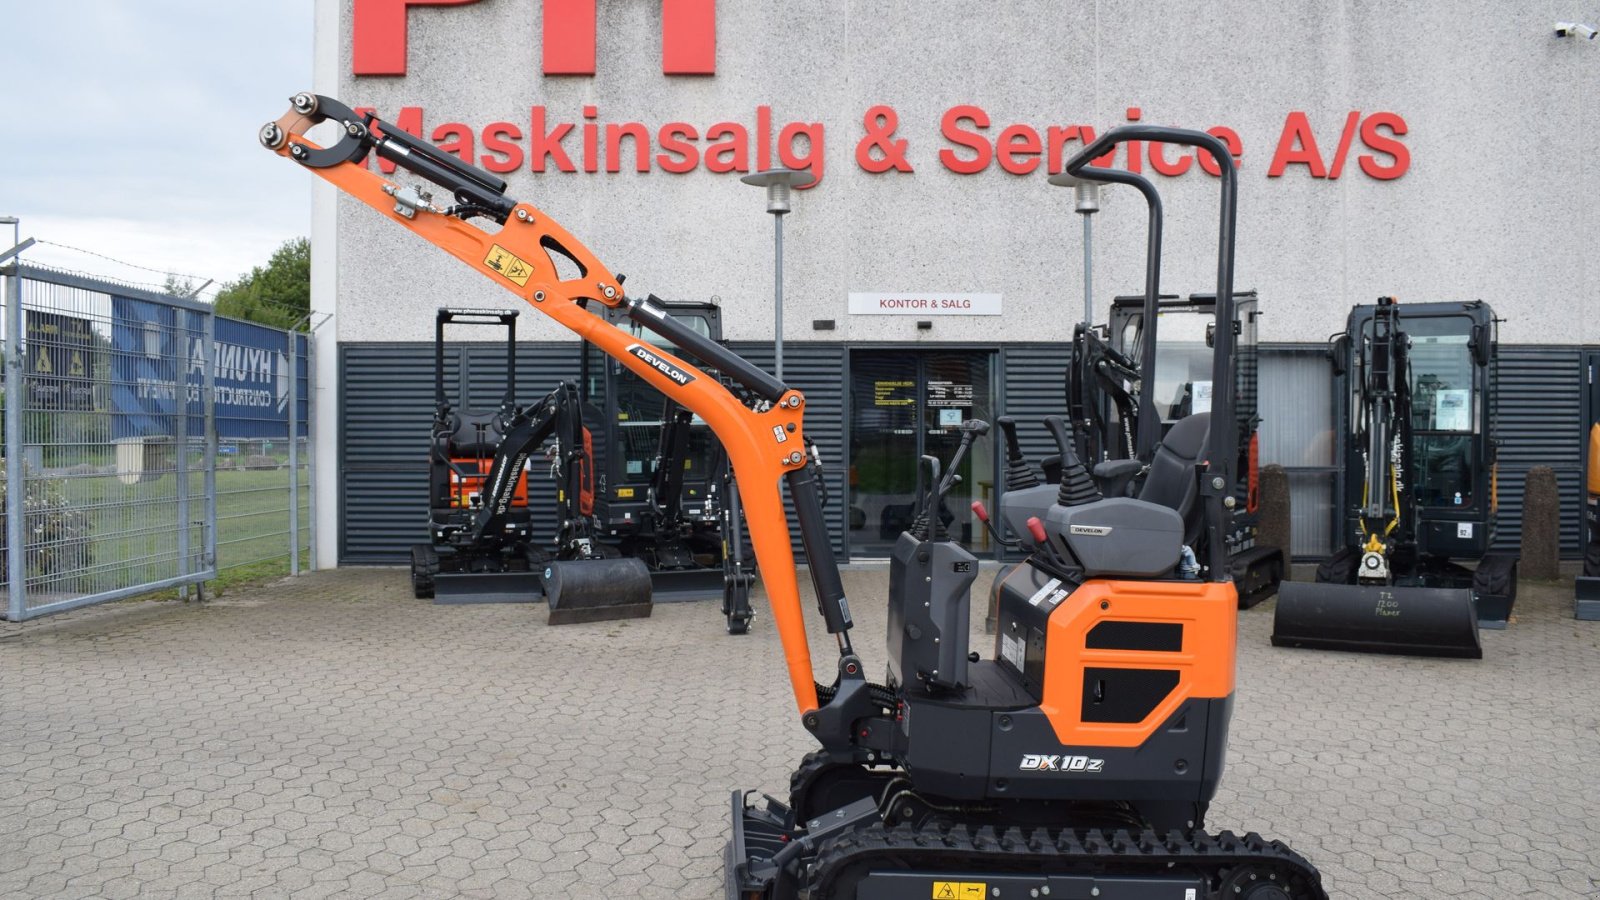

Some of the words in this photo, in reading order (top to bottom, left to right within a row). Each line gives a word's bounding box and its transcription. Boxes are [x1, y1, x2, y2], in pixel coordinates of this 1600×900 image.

[855, 104, 915, 174] &
[1267, 110, 1412, 180] A/S
[880, 299, 928, 308] KONTOR
[931, 299, 938, 308] &
[941, 299, 971, 308] SALG
[637, 349, 687, 384] DEVELON
